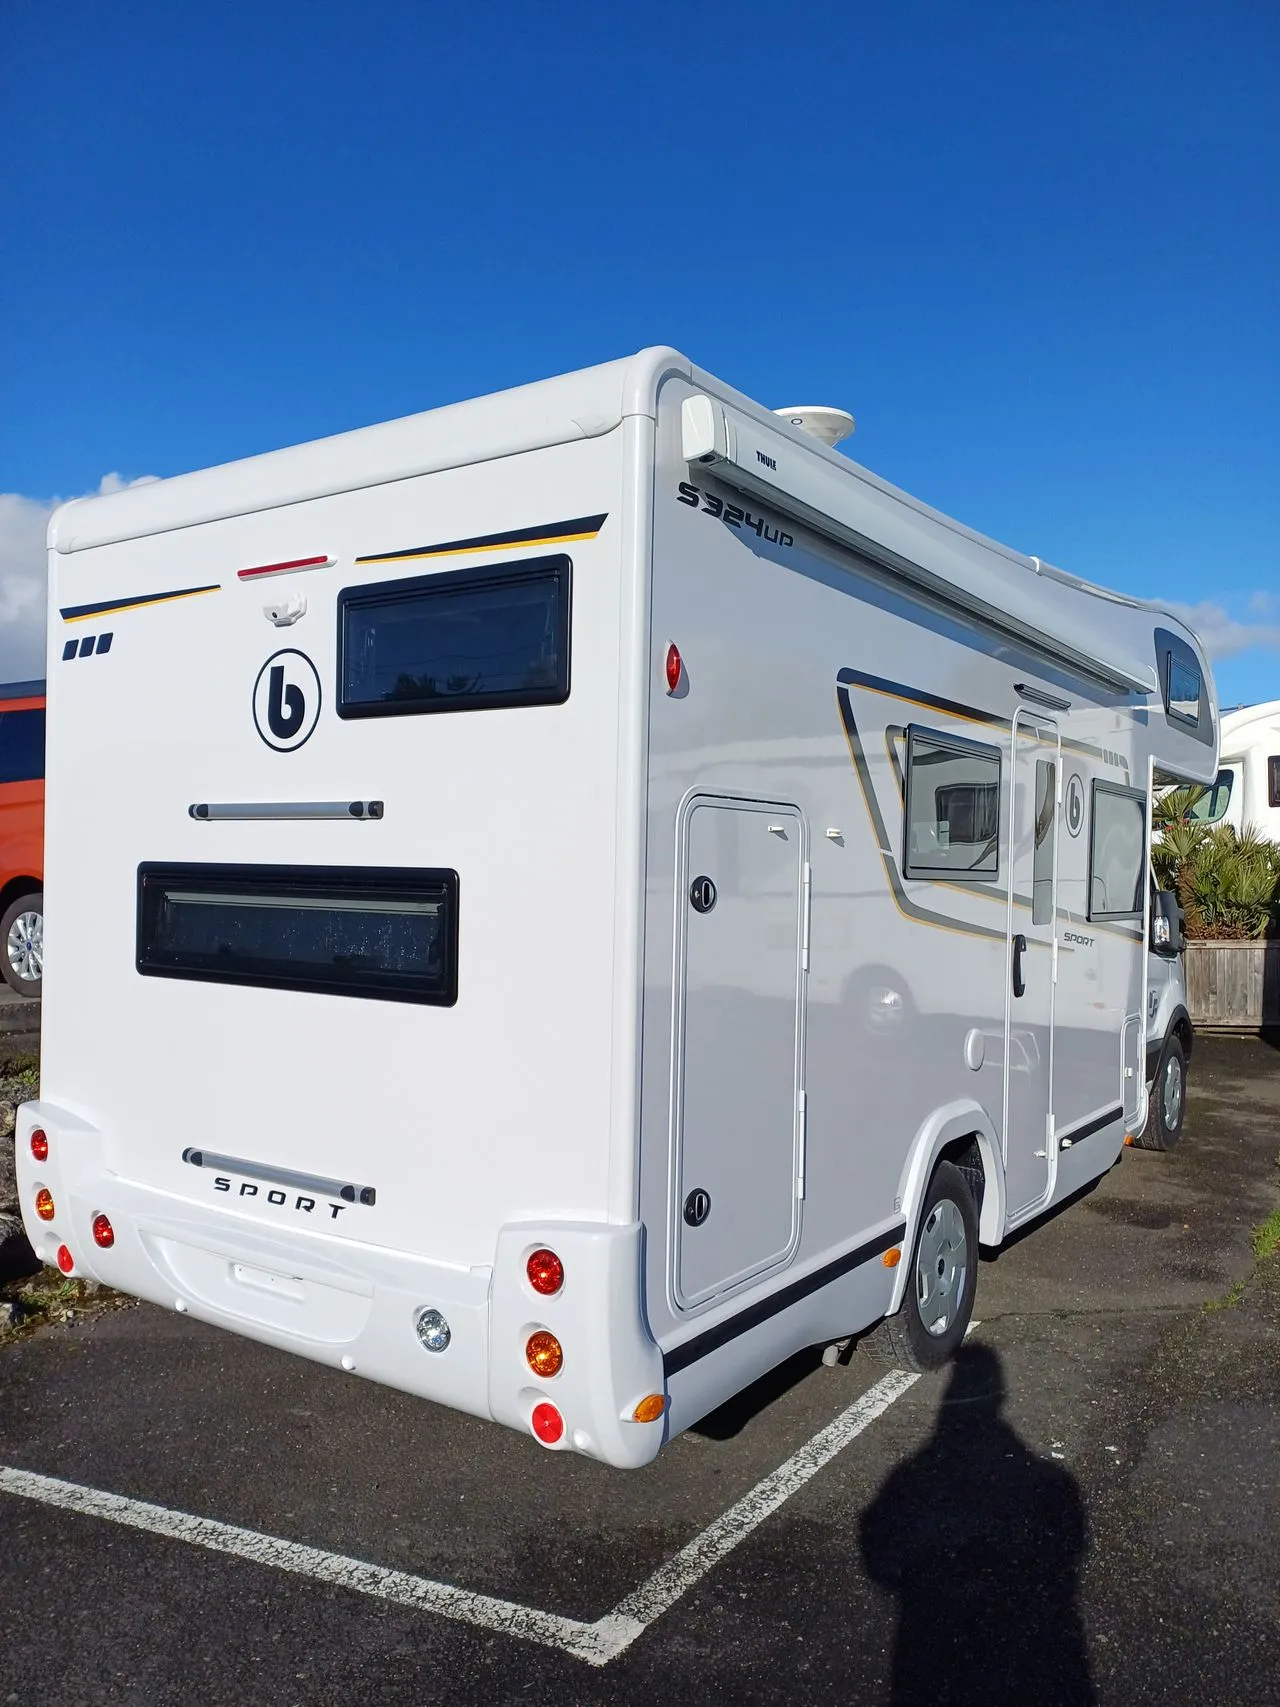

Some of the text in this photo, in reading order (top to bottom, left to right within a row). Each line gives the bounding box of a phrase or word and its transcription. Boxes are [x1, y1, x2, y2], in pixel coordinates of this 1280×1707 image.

[756, 450, 777, 471] THULE
[1063, 932, 1096, 947] SPORT
[214, 1177, 347, 1219] SPORT
